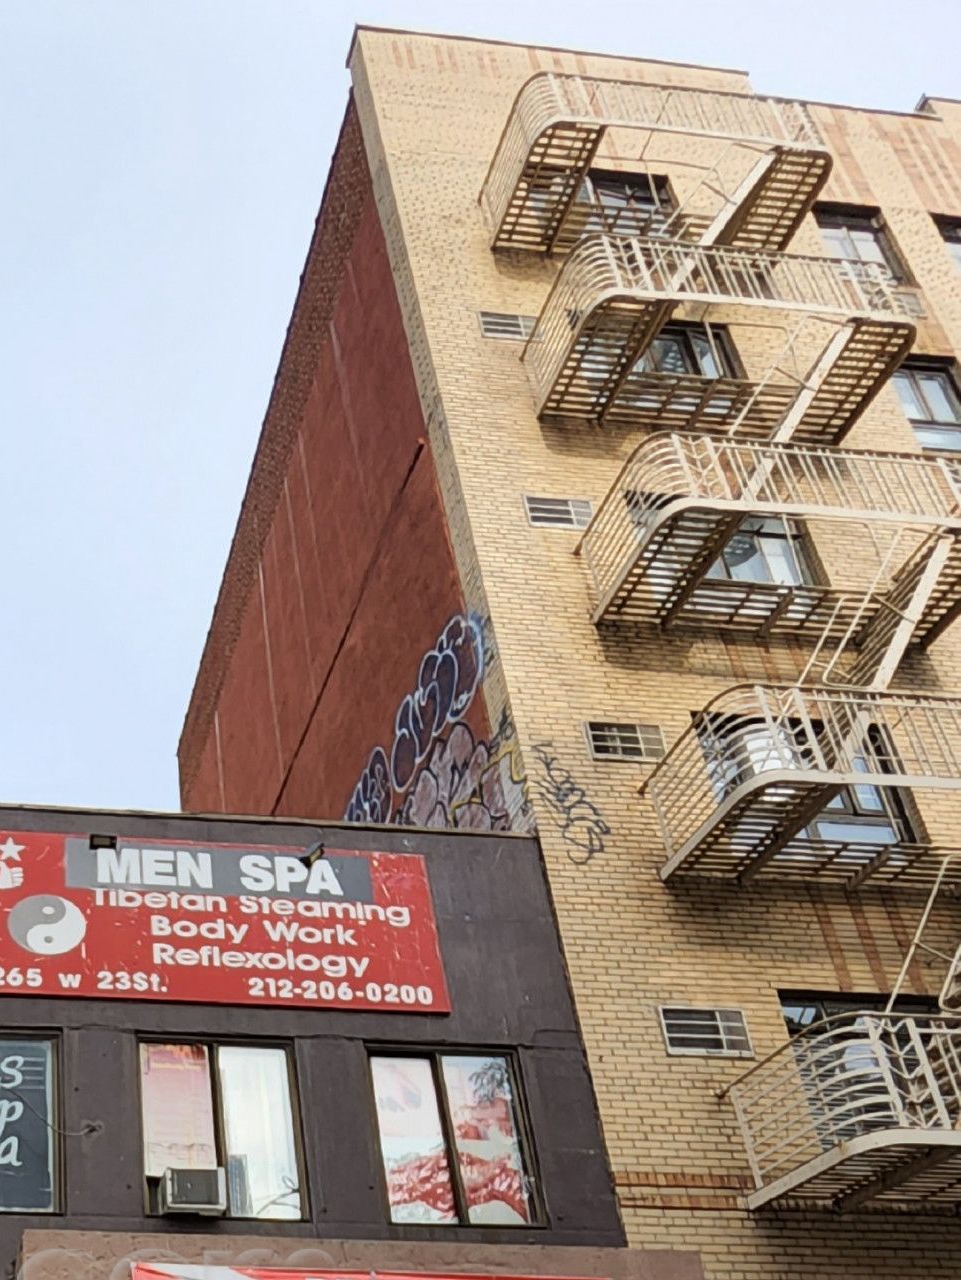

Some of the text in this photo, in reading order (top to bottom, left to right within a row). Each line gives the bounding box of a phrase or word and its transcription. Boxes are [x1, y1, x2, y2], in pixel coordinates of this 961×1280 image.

[97, 848, 344, 896] MEN SPA
[93, 887, 412, 927] Tibetan Steaming
[151, 917, 358, 946] Body Work
[152, 943, 371, 978] Reflexology
[97, 971, 169, 993] 23St.
[248, 976, 434, 1005] 212-206-0200
